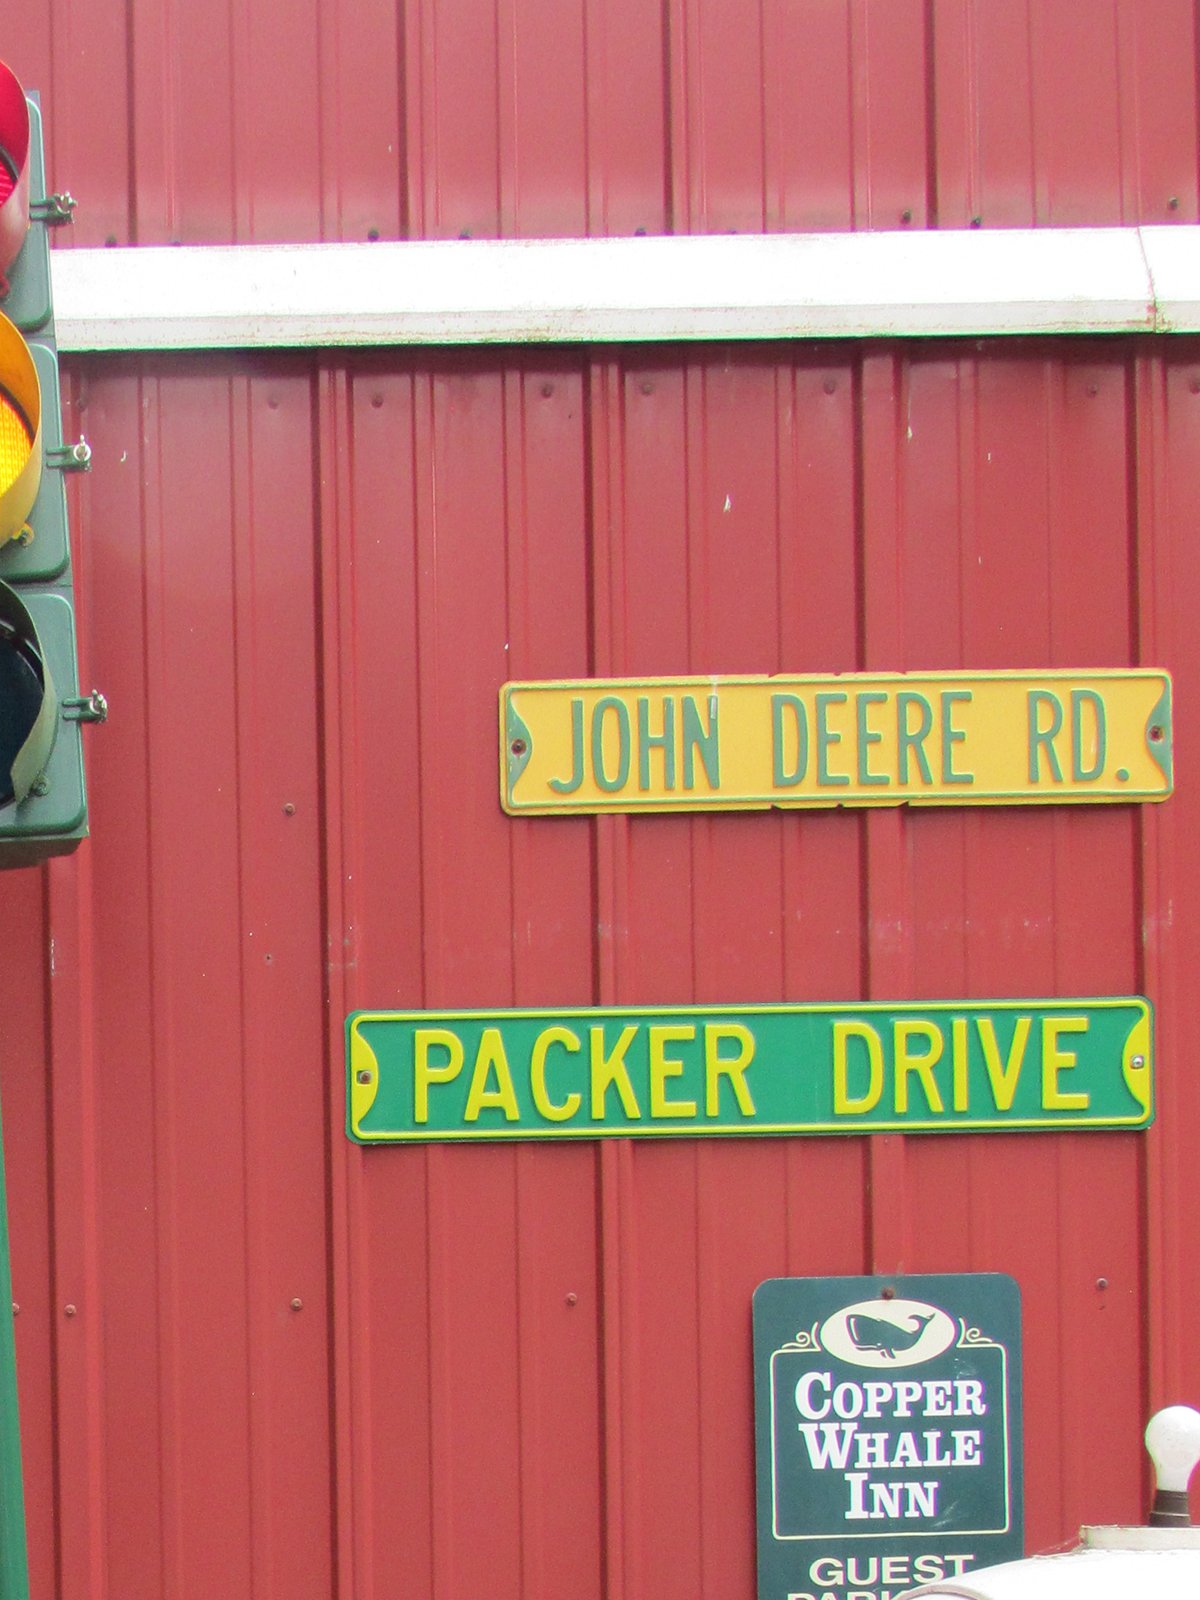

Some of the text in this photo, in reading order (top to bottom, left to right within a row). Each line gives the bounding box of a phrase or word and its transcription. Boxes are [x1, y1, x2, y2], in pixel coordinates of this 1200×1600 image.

[547, 688, 1130, 794] JOHN DEERE RD.
[414, 1017, 1088, 1123] PACKER DRIVE
[795, 1371, 987, 1420] COPPER
[798, 1422, 982, 1469] WHALE
[844, 1472, 939, 1520] INN
[809, 1554, 974, 1586] GUEST
